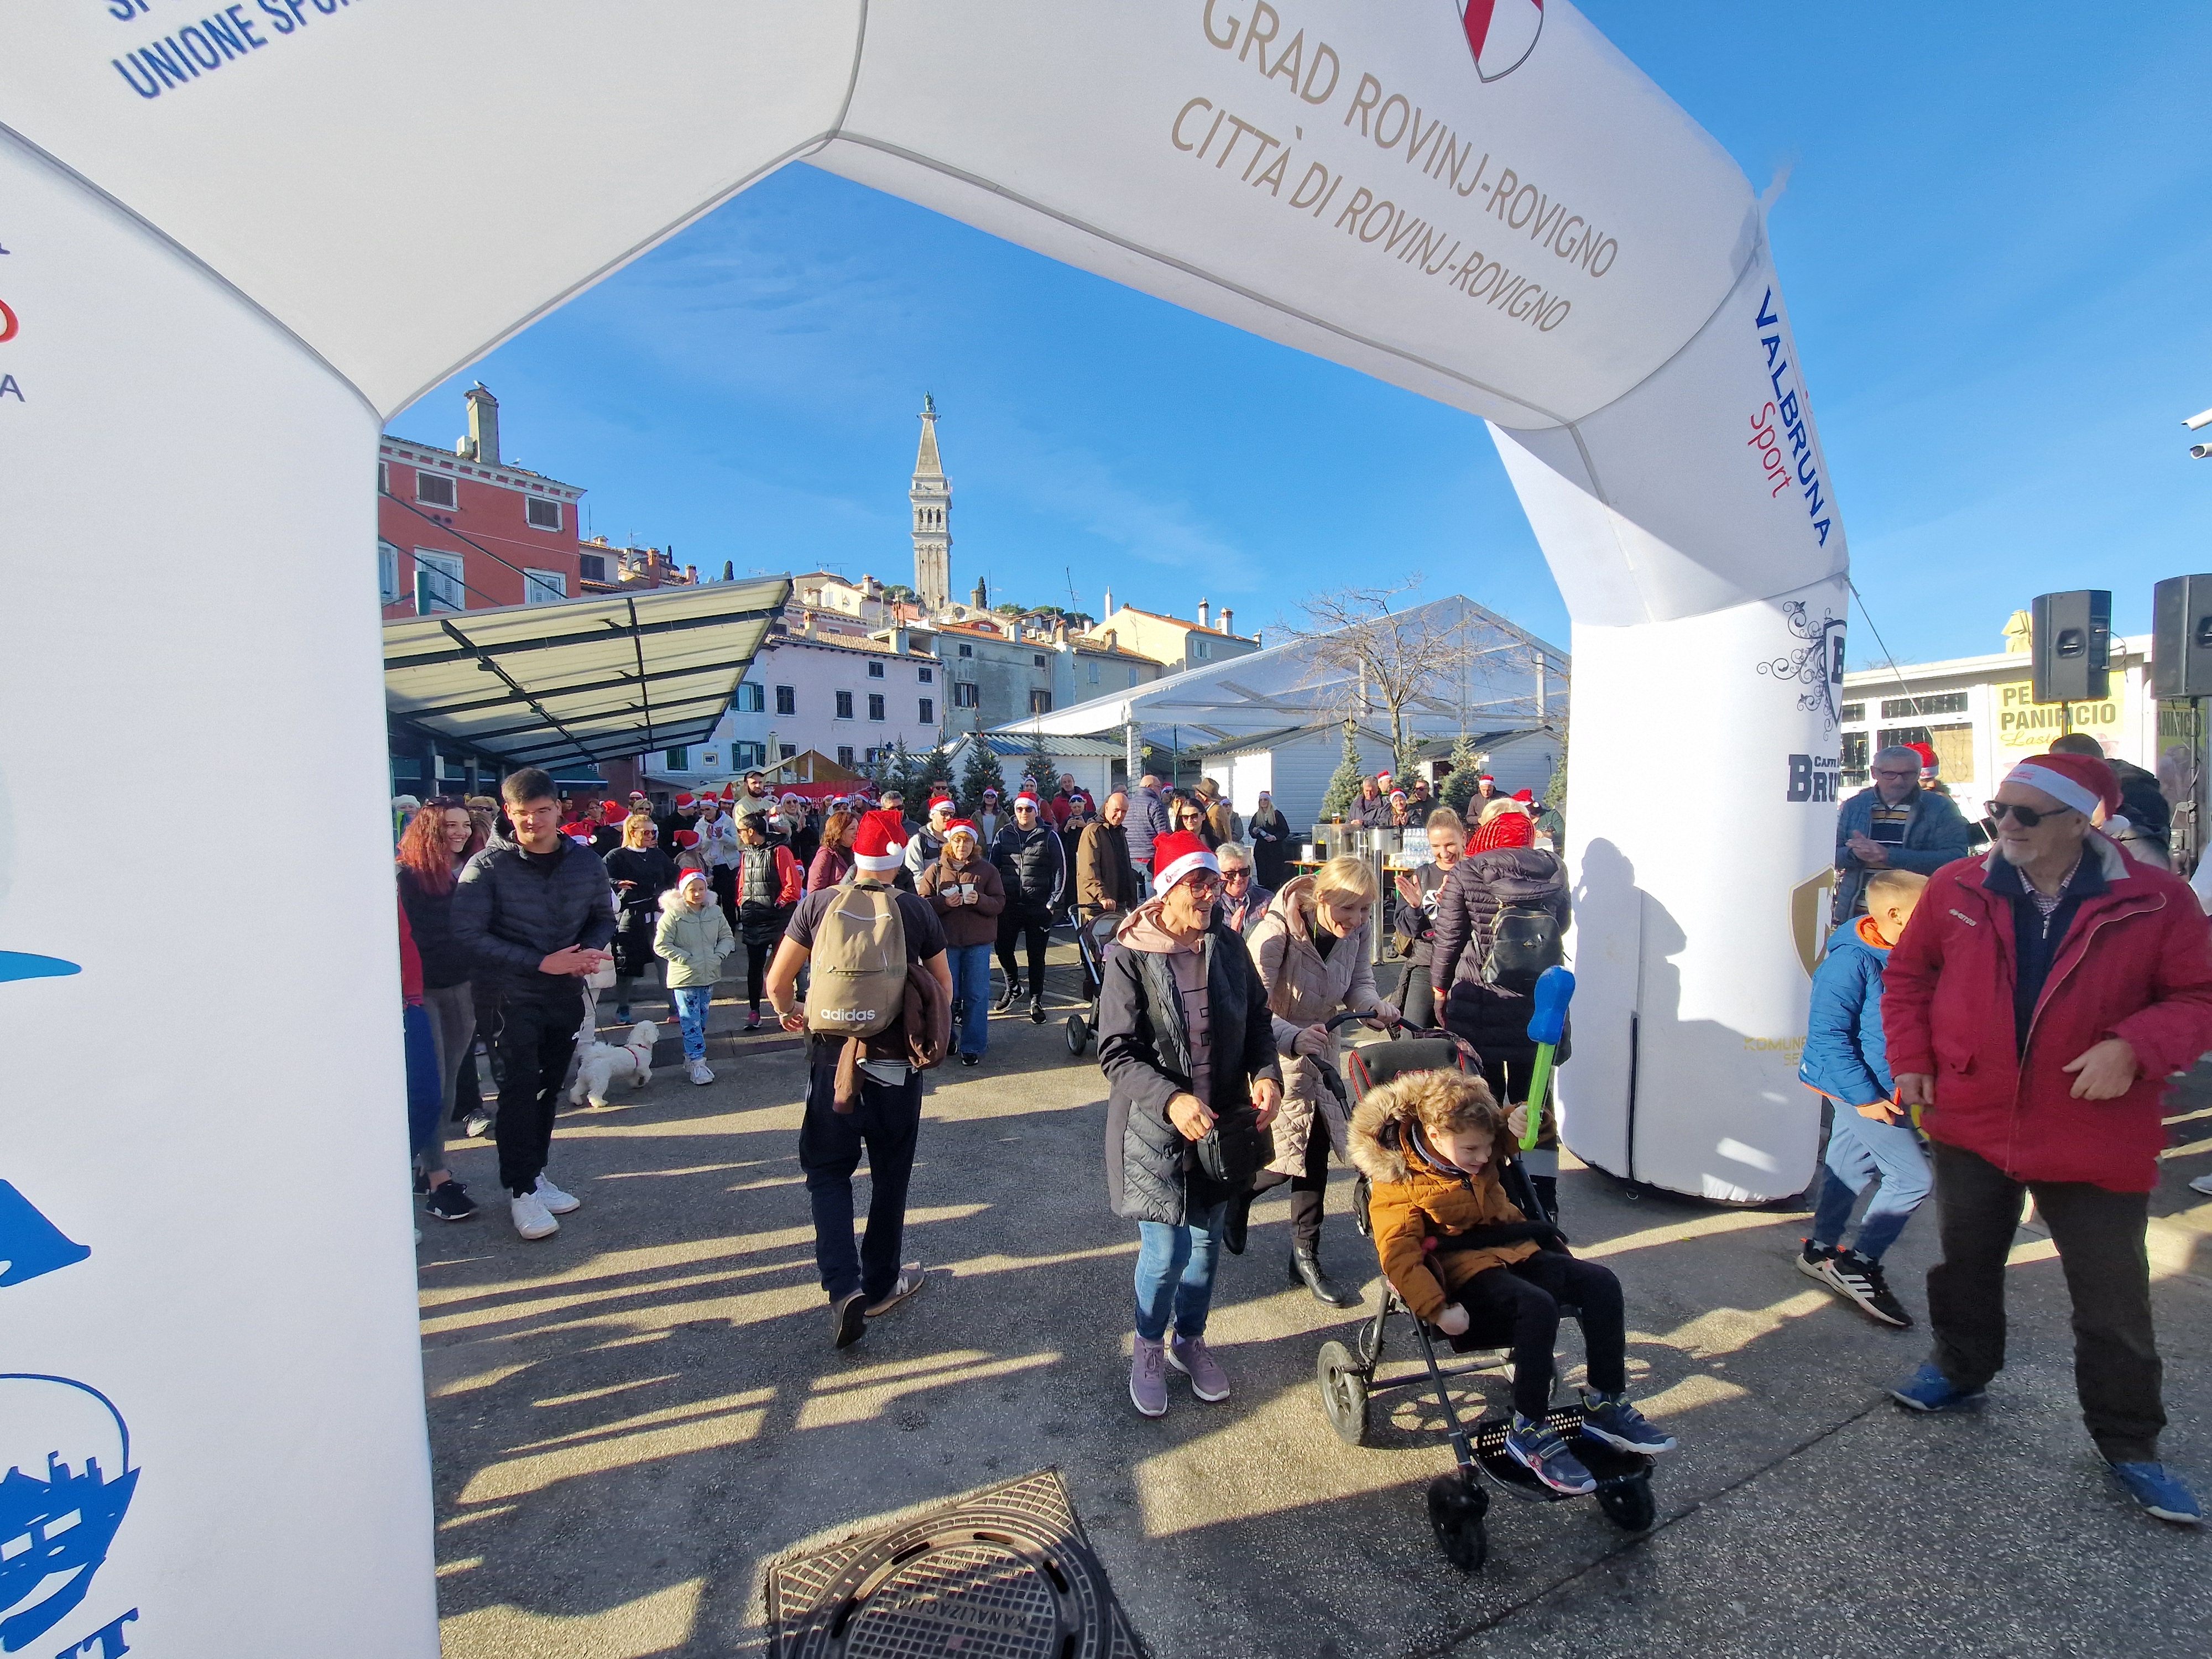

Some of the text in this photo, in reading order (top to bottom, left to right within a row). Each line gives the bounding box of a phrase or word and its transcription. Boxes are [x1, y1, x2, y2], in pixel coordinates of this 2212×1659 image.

[112, 4, 269, 99] UNIONE
[1202, 0, 1618, 278] GRAD ROVINJ-ROVIGNO
[1171, 97, 1572, 332] CITTÀ DI ROVINJ-ROVIGNO
[1747, 401, 1793, 498] Sport
[1755, 284, 1832, 549] VALBRUNA
[2001, 703, 2116, 731] PANIFICIO
[820, 1008, 876, 1021] adidas
[898, 1594, 1028, 1630] KANALIZACIJA
